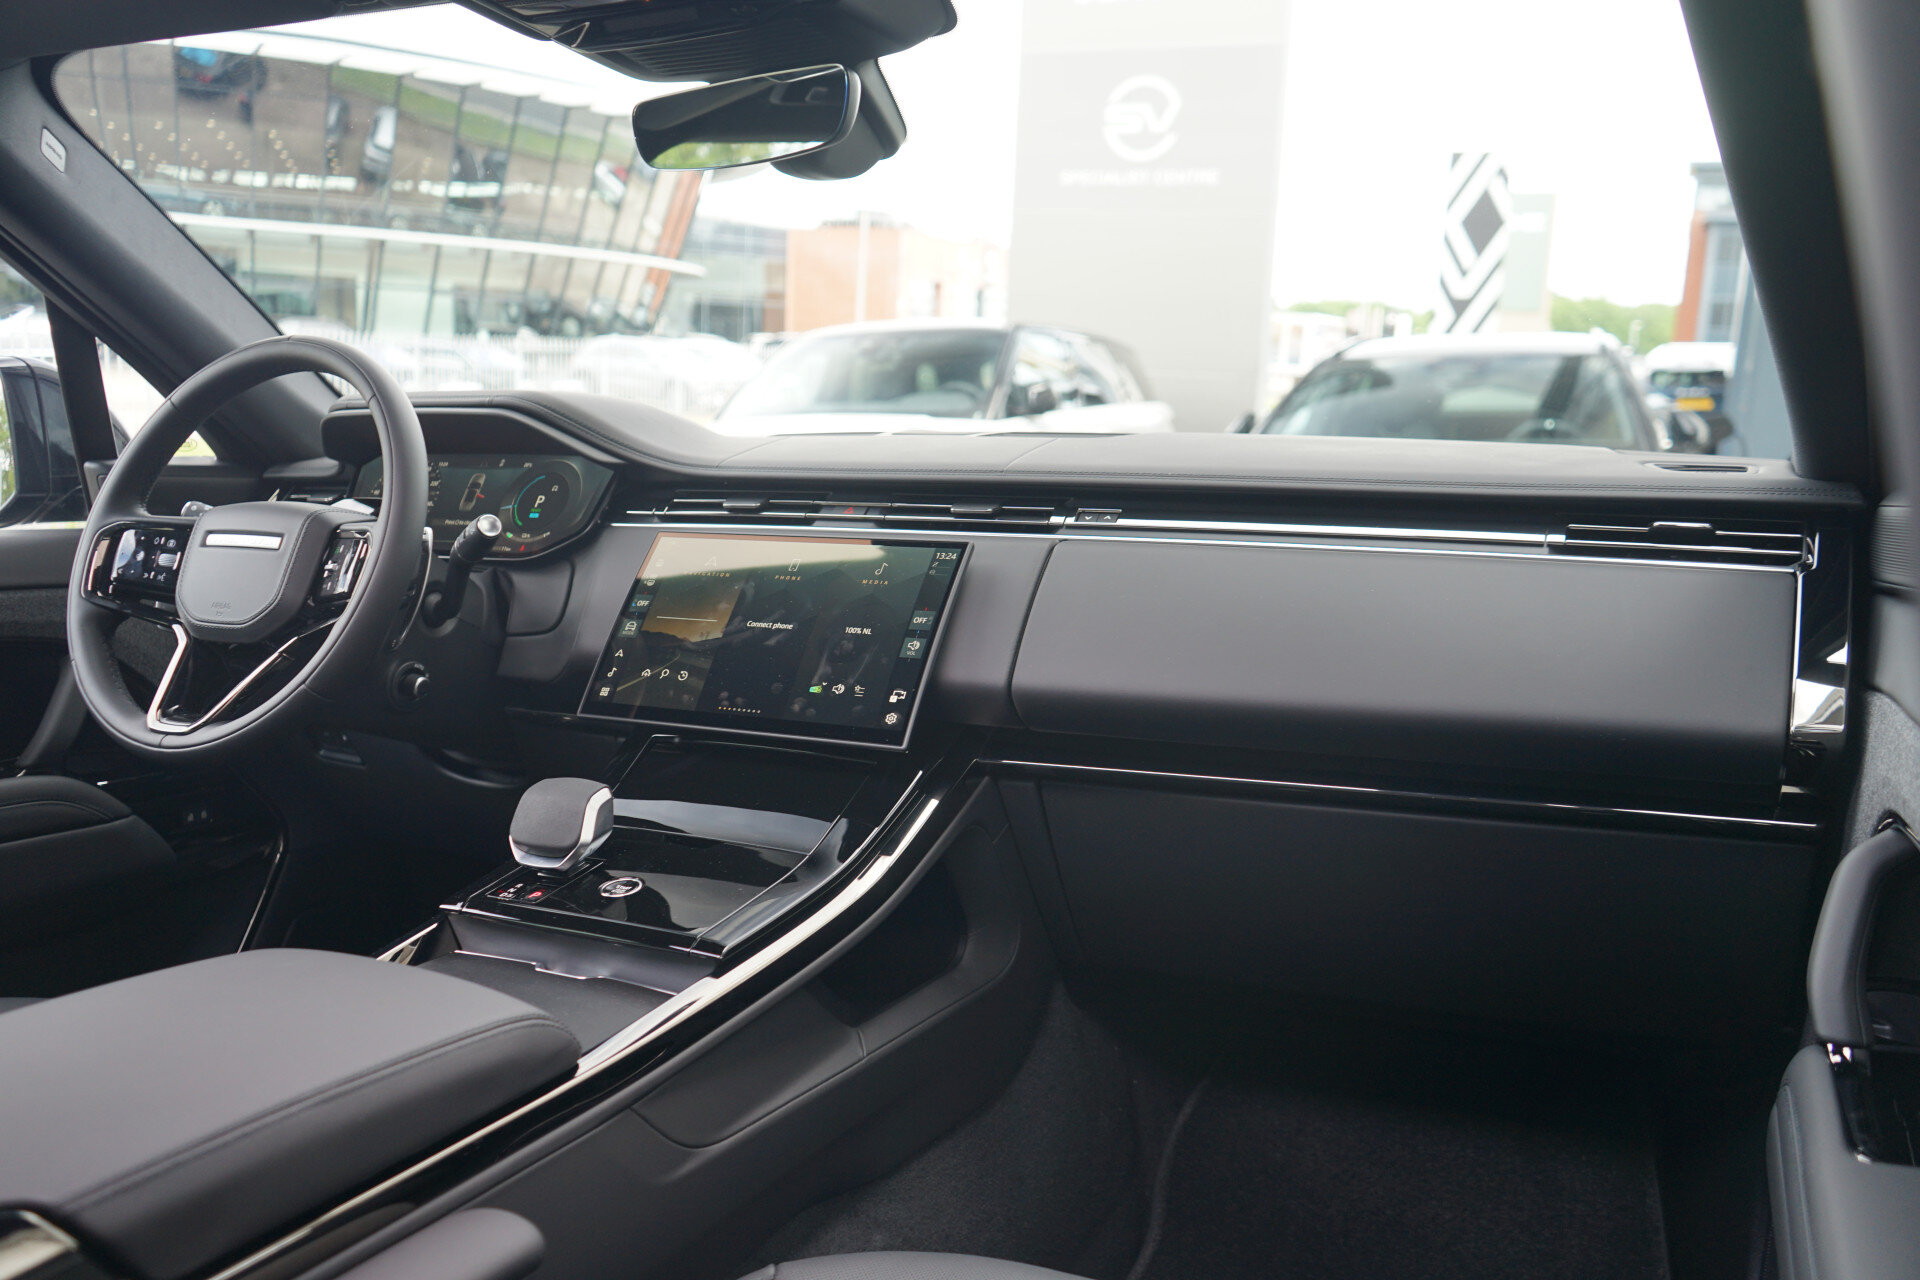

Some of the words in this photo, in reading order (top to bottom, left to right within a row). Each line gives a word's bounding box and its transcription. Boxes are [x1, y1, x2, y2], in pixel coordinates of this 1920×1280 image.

[1060, 169, 1149, 186] SPECIALIST
[1152, 169, 1220, 186] CENTRE
[534, 495, 545, 508] P
[935, 552, 957, 560] 13:24
[913, 616, 928, 624] OFF
[747, 620, 772, 629] Connect
[772, 622, 794, 630] phone
[845, 626, 862, 634] 100%
[862, 627, 872, 635] NL
